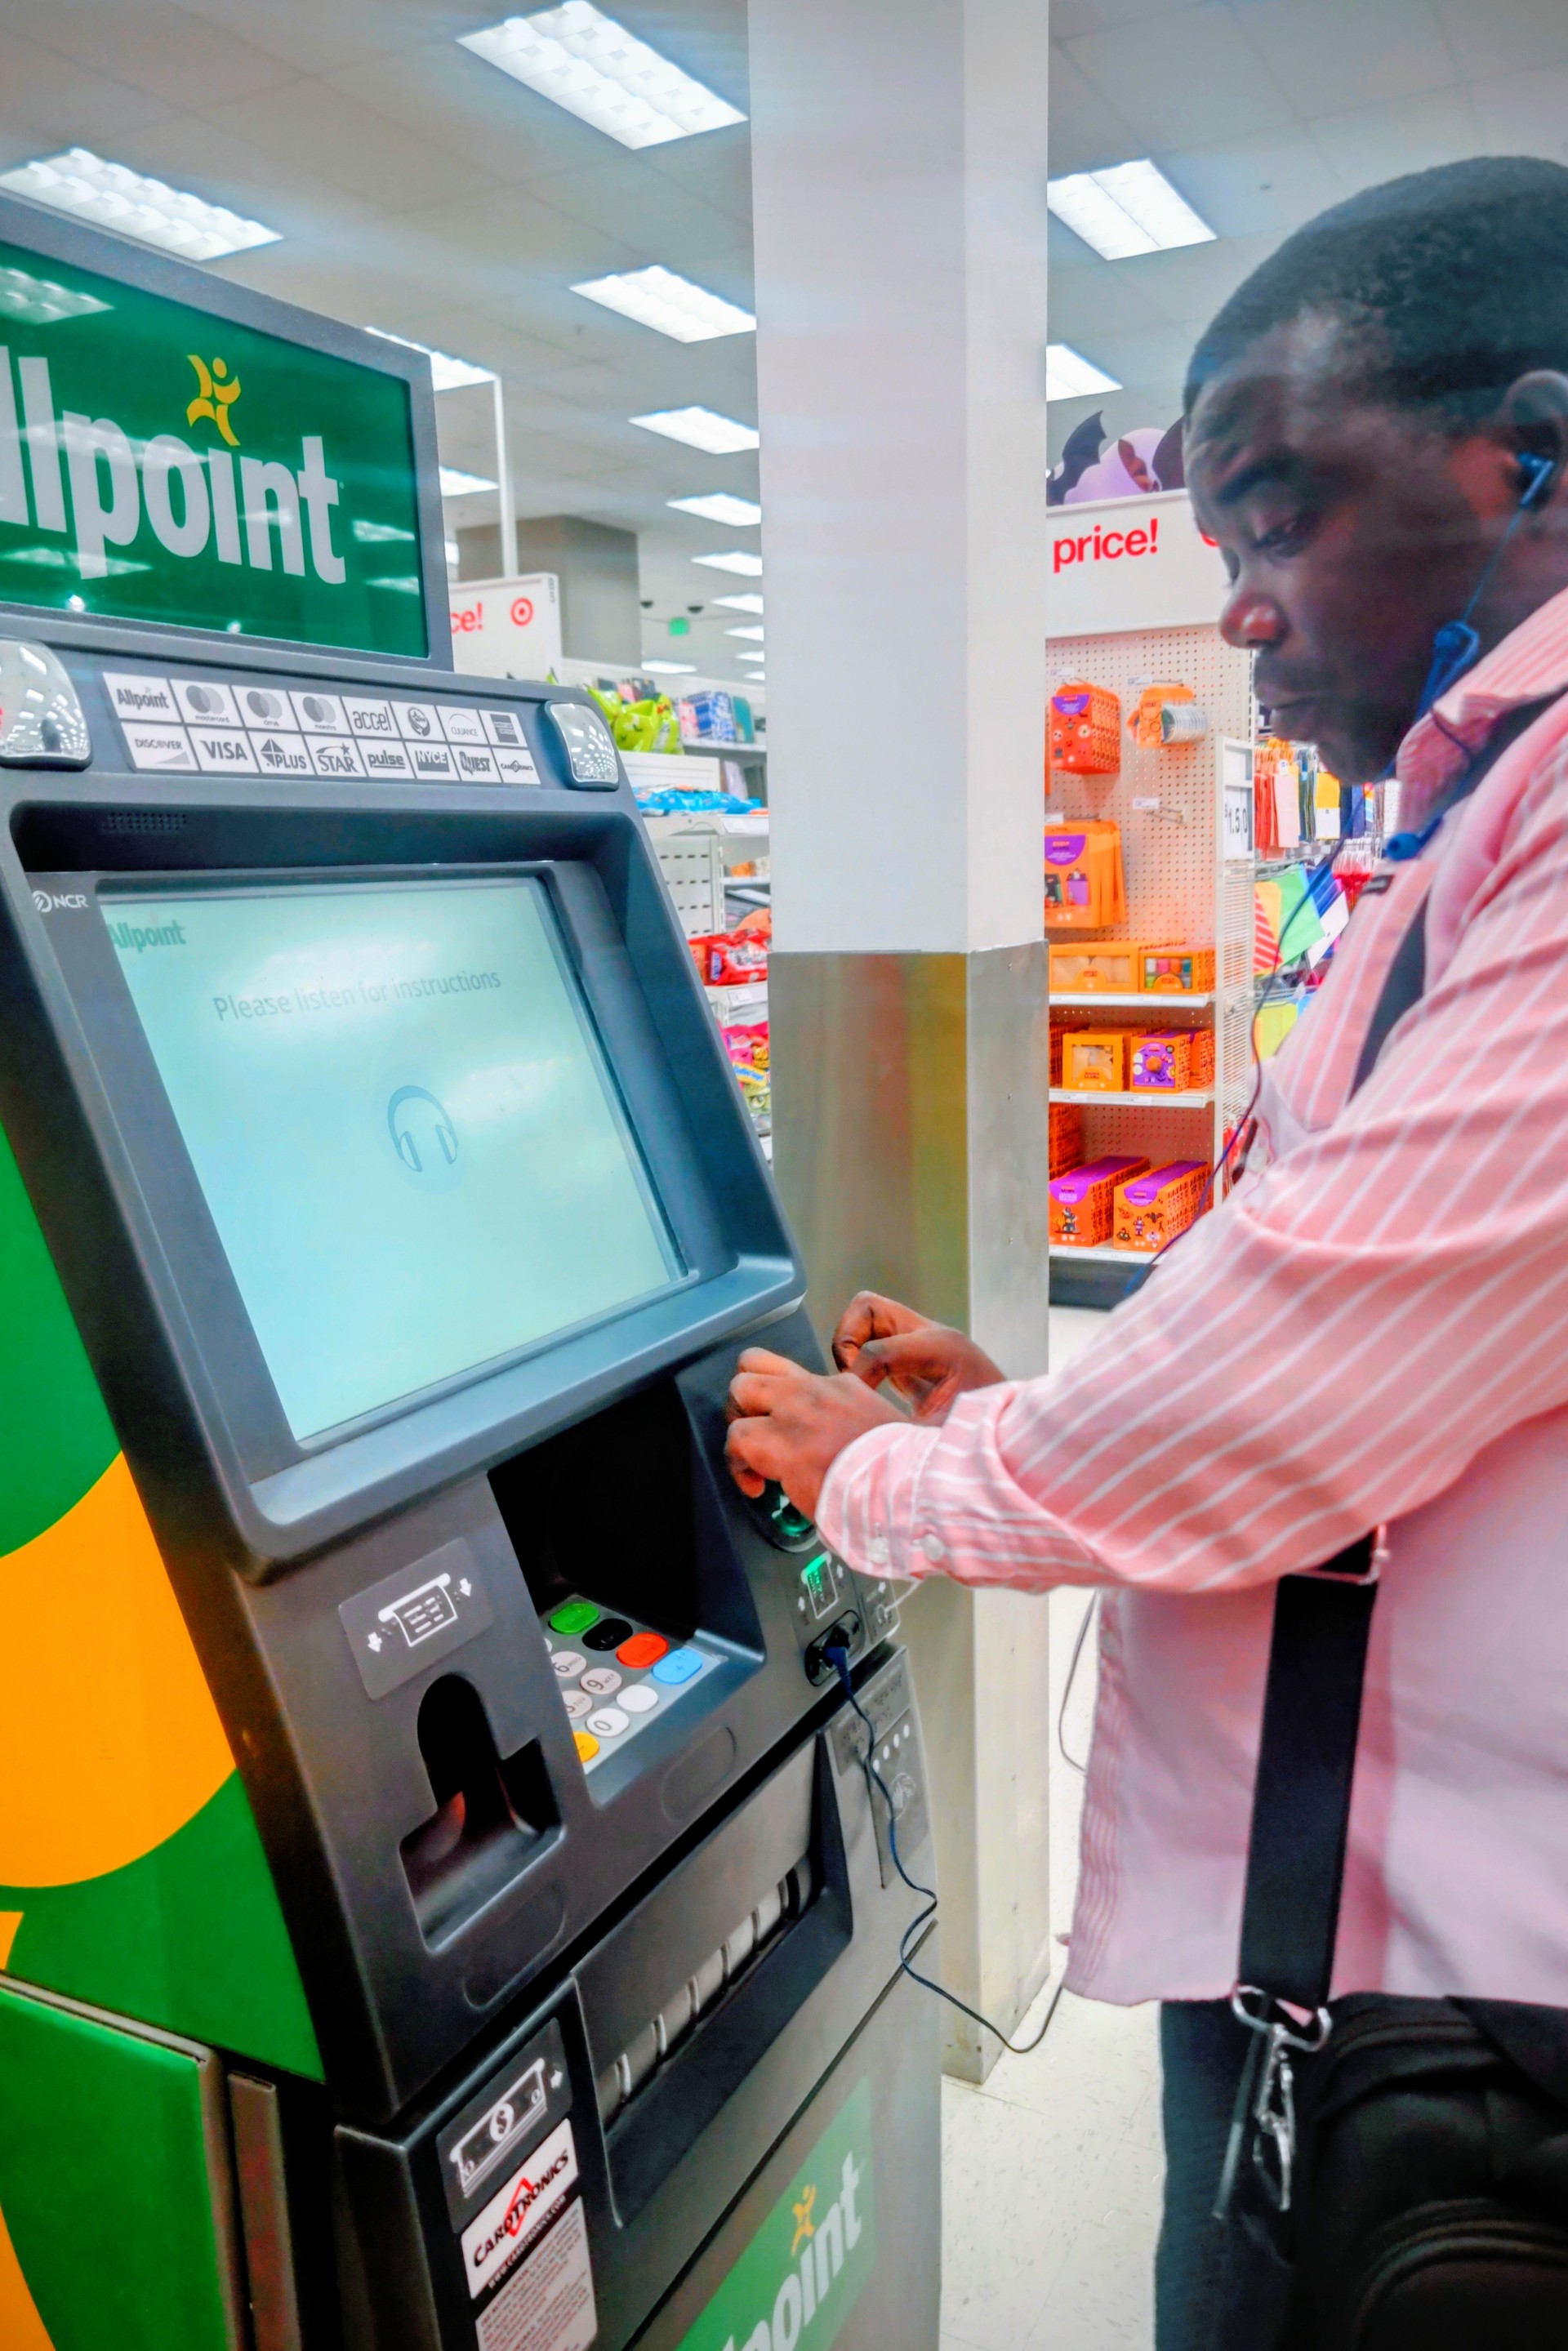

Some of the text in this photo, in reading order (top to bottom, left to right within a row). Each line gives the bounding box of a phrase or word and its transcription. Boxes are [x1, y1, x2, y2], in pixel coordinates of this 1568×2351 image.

[1054, 518, 1158, 573] price!
[116, 688, 169, 710] Allpoint
[353, 706, 392, 731] accel
[134, 738, 183, 750] DISCOVER
[198, 740, 248, 760] VISA
[275, 755, 307, 769] PLUS
[317, 755, 360, 773] STAR
[367, 750, 406, 768] pulse
[417, 750, 448, 764] NYCE
[54, 894, 89, 909] NCR
[212, 969, 502, 1021] Please listen for instructions
[554, 1663, 569, 1673] 6
[586, 1680, 604, 1691] 9
[595, 1721, 612, 1731] 0
